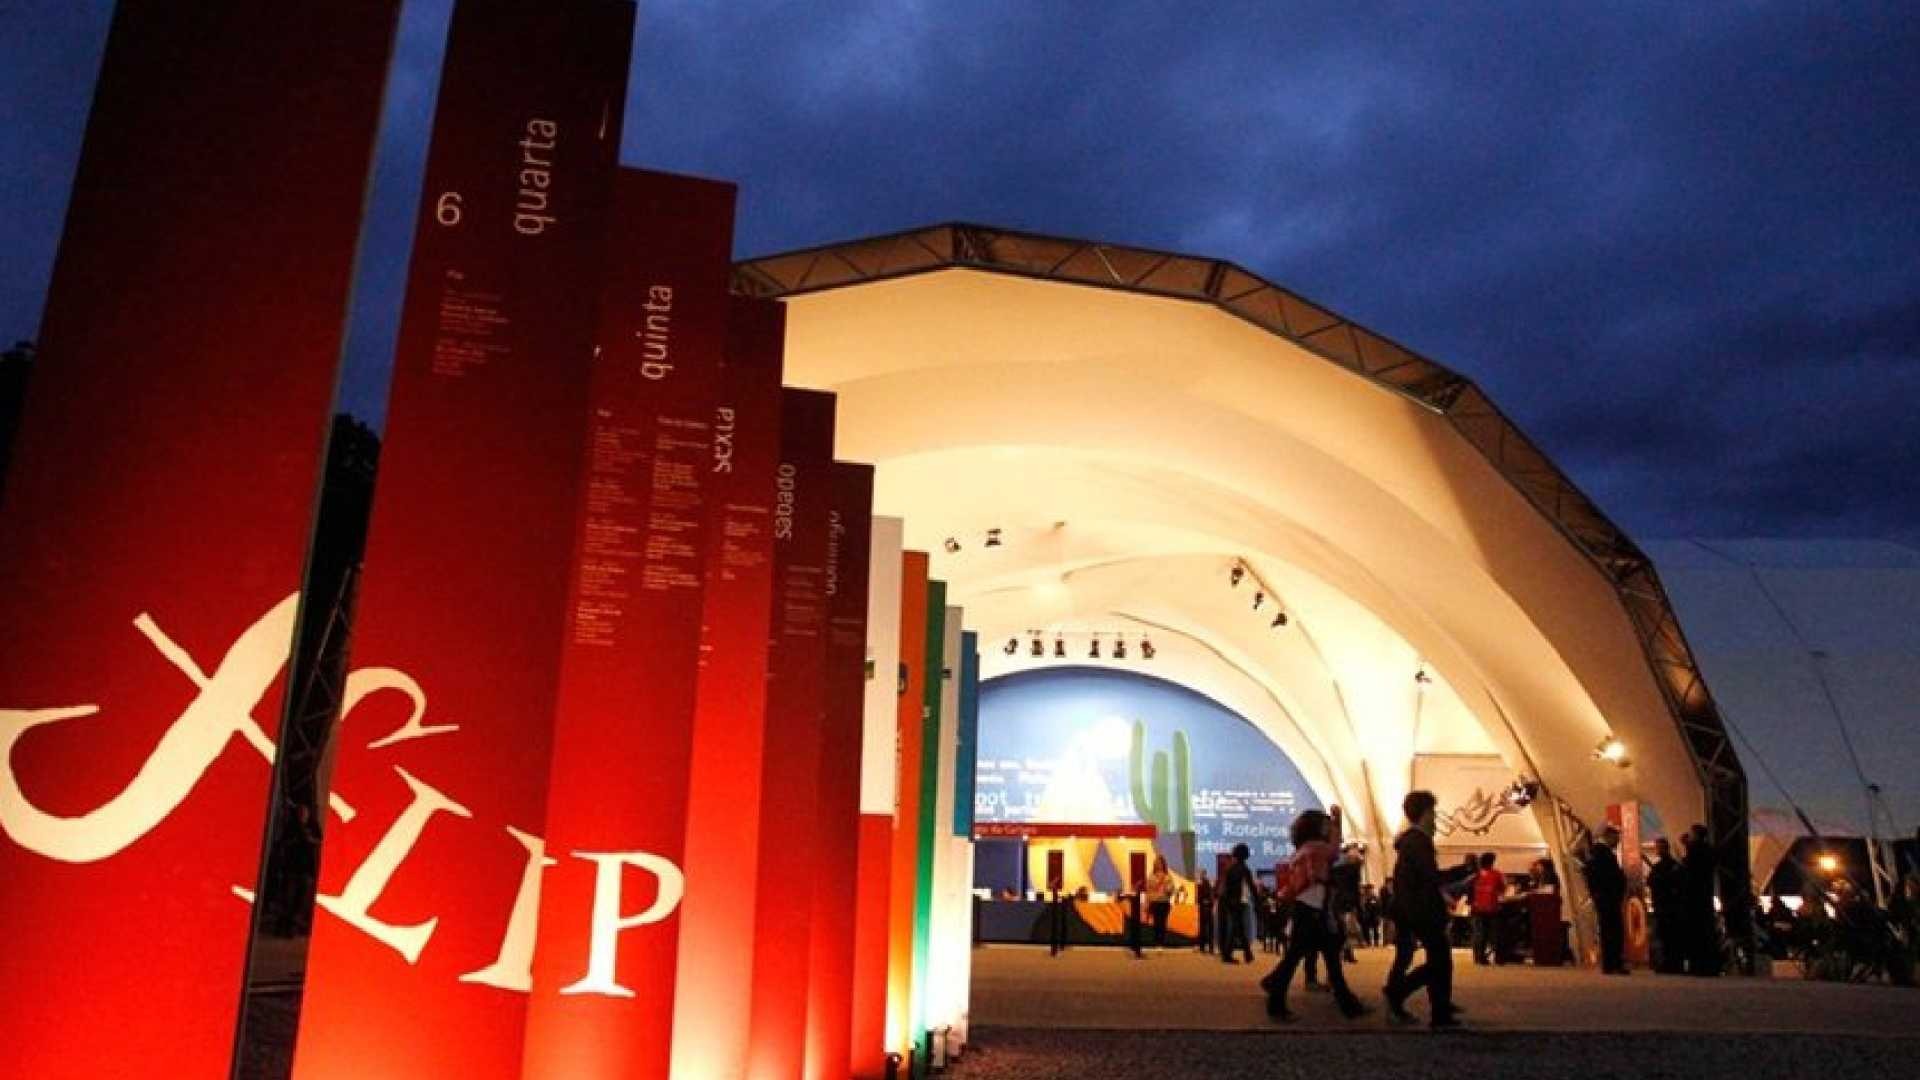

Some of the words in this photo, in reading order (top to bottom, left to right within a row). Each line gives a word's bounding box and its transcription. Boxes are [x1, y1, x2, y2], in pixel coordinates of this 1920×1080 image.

[436, 191, 463, 226] 6
[514, 118, 557, 235] quarta
[636, 285, 673, 381] quinta
